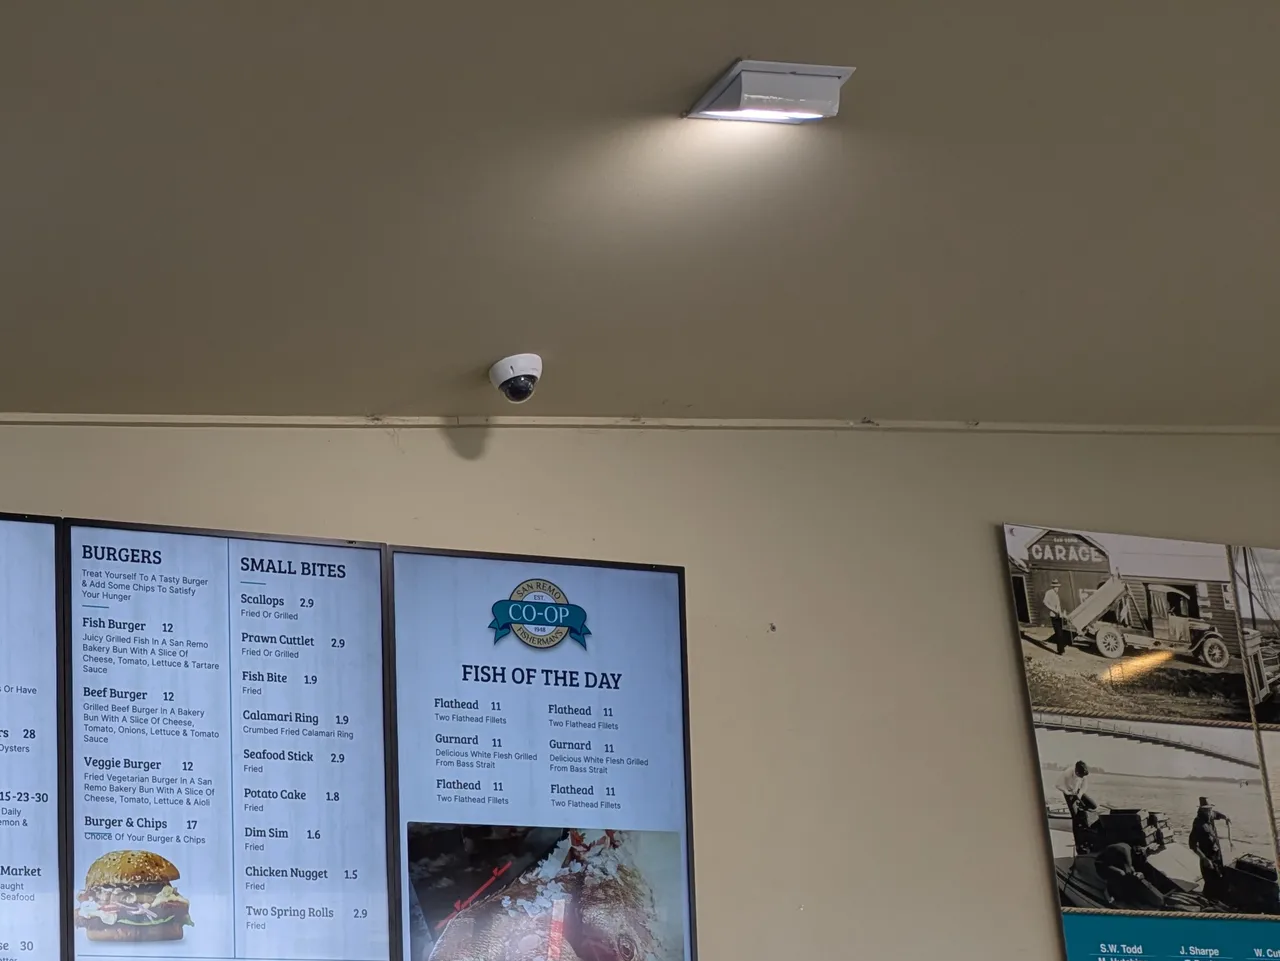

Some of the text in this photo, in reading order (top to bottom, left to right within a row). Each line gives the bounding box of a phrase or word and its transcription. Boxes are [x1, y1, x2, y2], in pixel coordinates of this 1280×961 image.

[82, 545, 162, 564] BURGERS
[241, 557, 346, 578] SMALL BITES
[241, 594, 314, 608] Scallops 2.9
[241, 609, 260, 617] Fried
[274, 611, 298, 620] Grilled
[508, 603, 570, 624] CO-OP
[83, 617, 173, 633] Fish Burger 12
[462, 665, 622, 689] FISH OF THE DAY
[434, 698, 501, 711] Flathead 11
[243, 710, 349, 726] Calamari Ring 1.9
[23, 729, 36, 739] 28
[84, 757, 193, 772] Veggie Burger 12
[244, 788, 339, 801] Potato Cake 1.8
[0, 866, 41, 876] Market
[245, 866, 357, 881] Chicken Nugget 1.5
[1100, 944, 1143, 954] S.W. Todd
